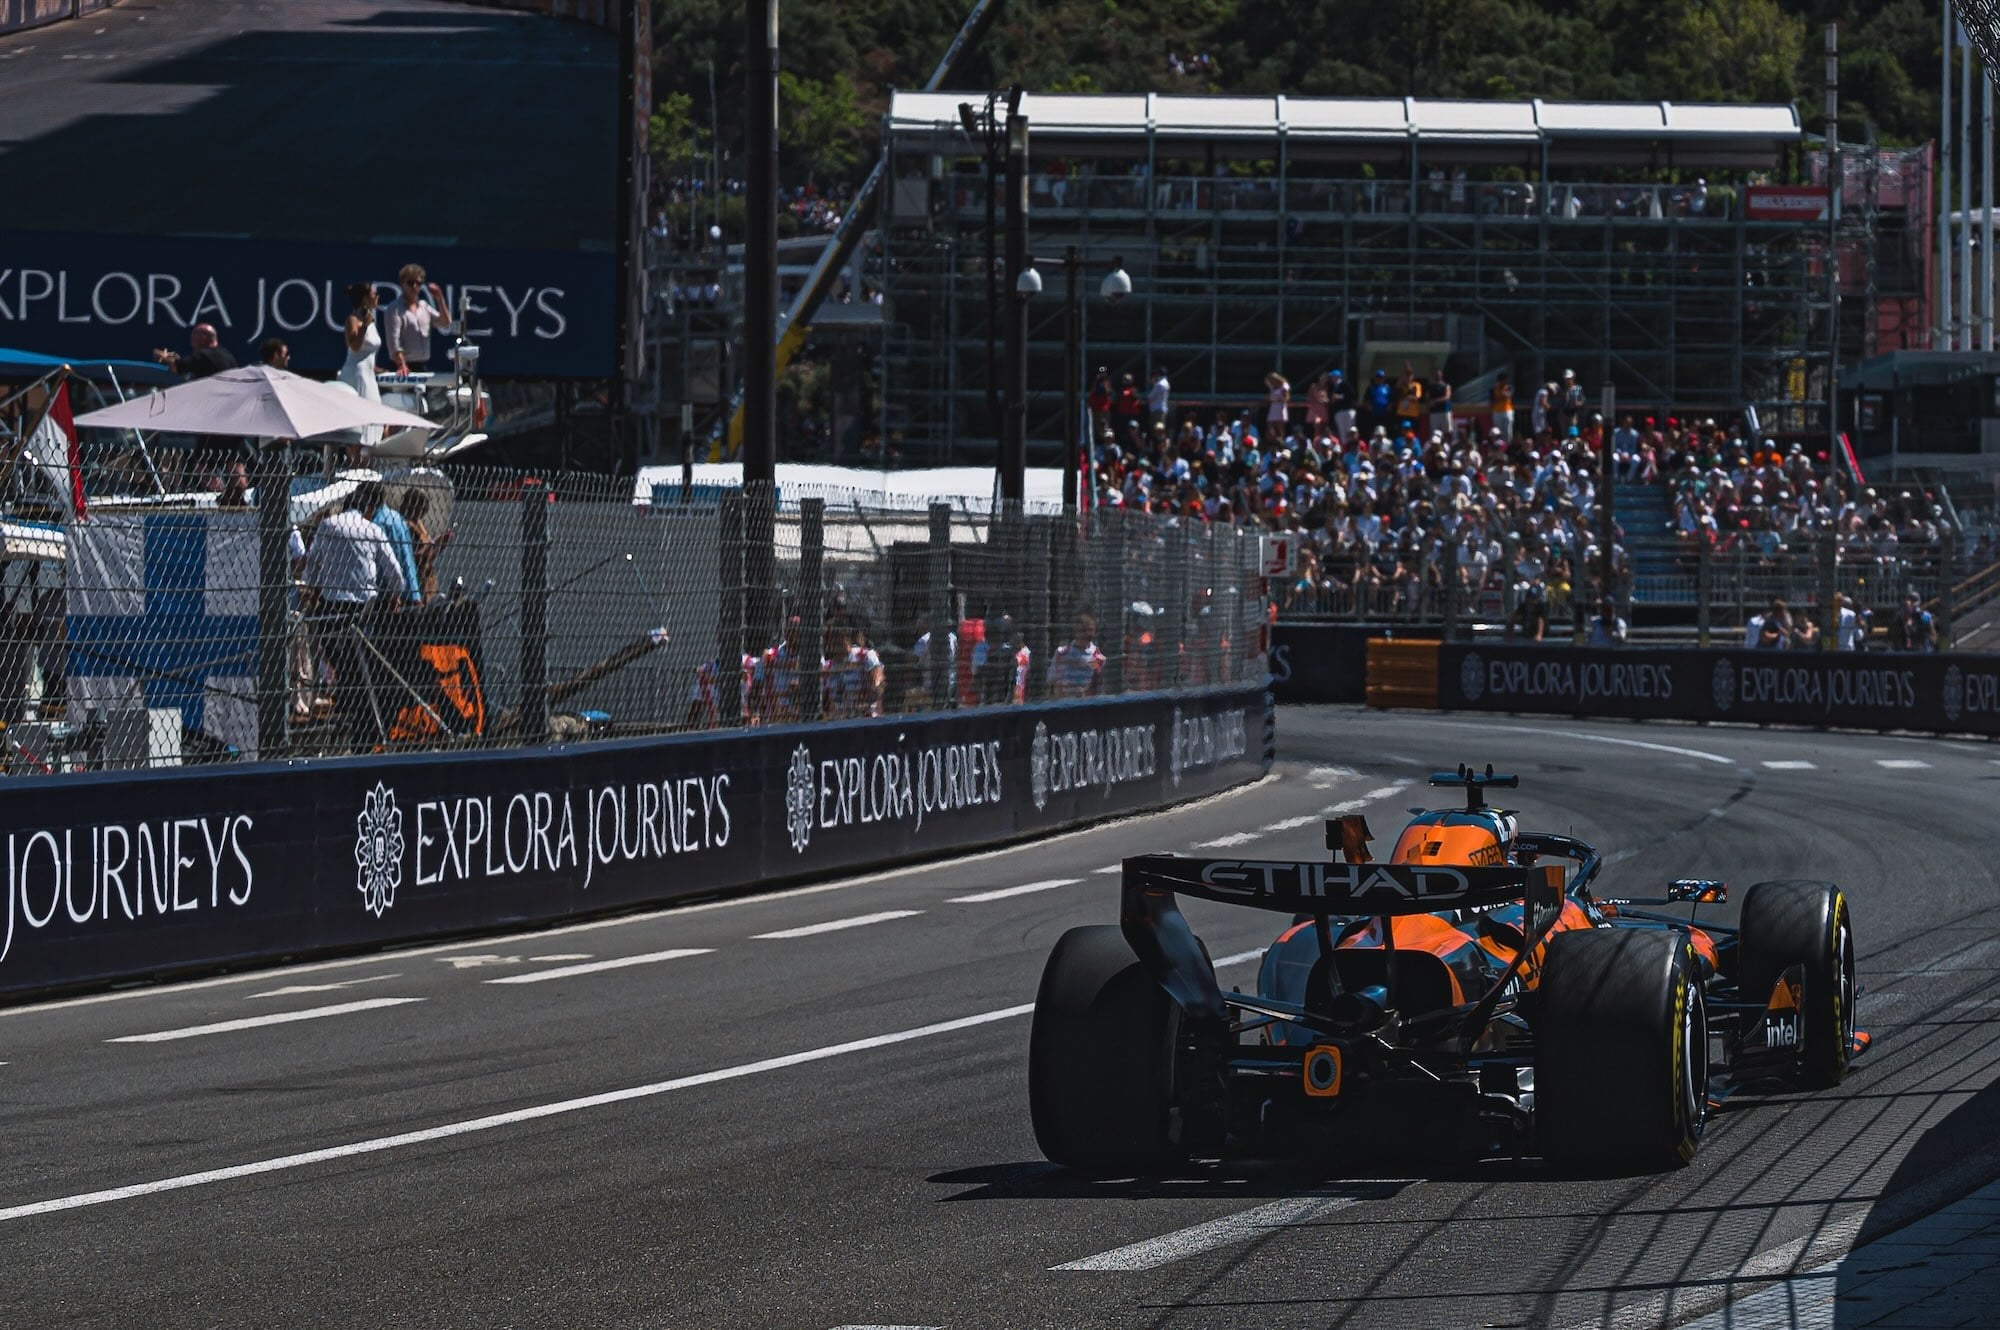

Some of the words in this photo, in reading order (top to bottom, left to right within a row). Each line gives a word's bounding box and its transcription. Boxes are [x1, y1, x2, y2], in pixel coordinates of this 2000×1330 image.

[1489, 661, 1576, 696] EXPLORA
[1579, 664, 1674, 703] JOURNEYS
[1741, 667, 1824, 704] EXPLORA
[1826, 669, 1916, 713] JOURNEYS
[820, 753, 914, 829] EXPLORA
[914, 740, 1002, 832] JOURNEYS
[416, 792, 578, 887] EXPLORA
[584, 774, 731, 889] JOURNEYS
[0, 814, 254, 963] JOURNEYS
[1201, 861, 1469, 900] ETIHAD
[1766, 1014, 1798, 1048] intel
